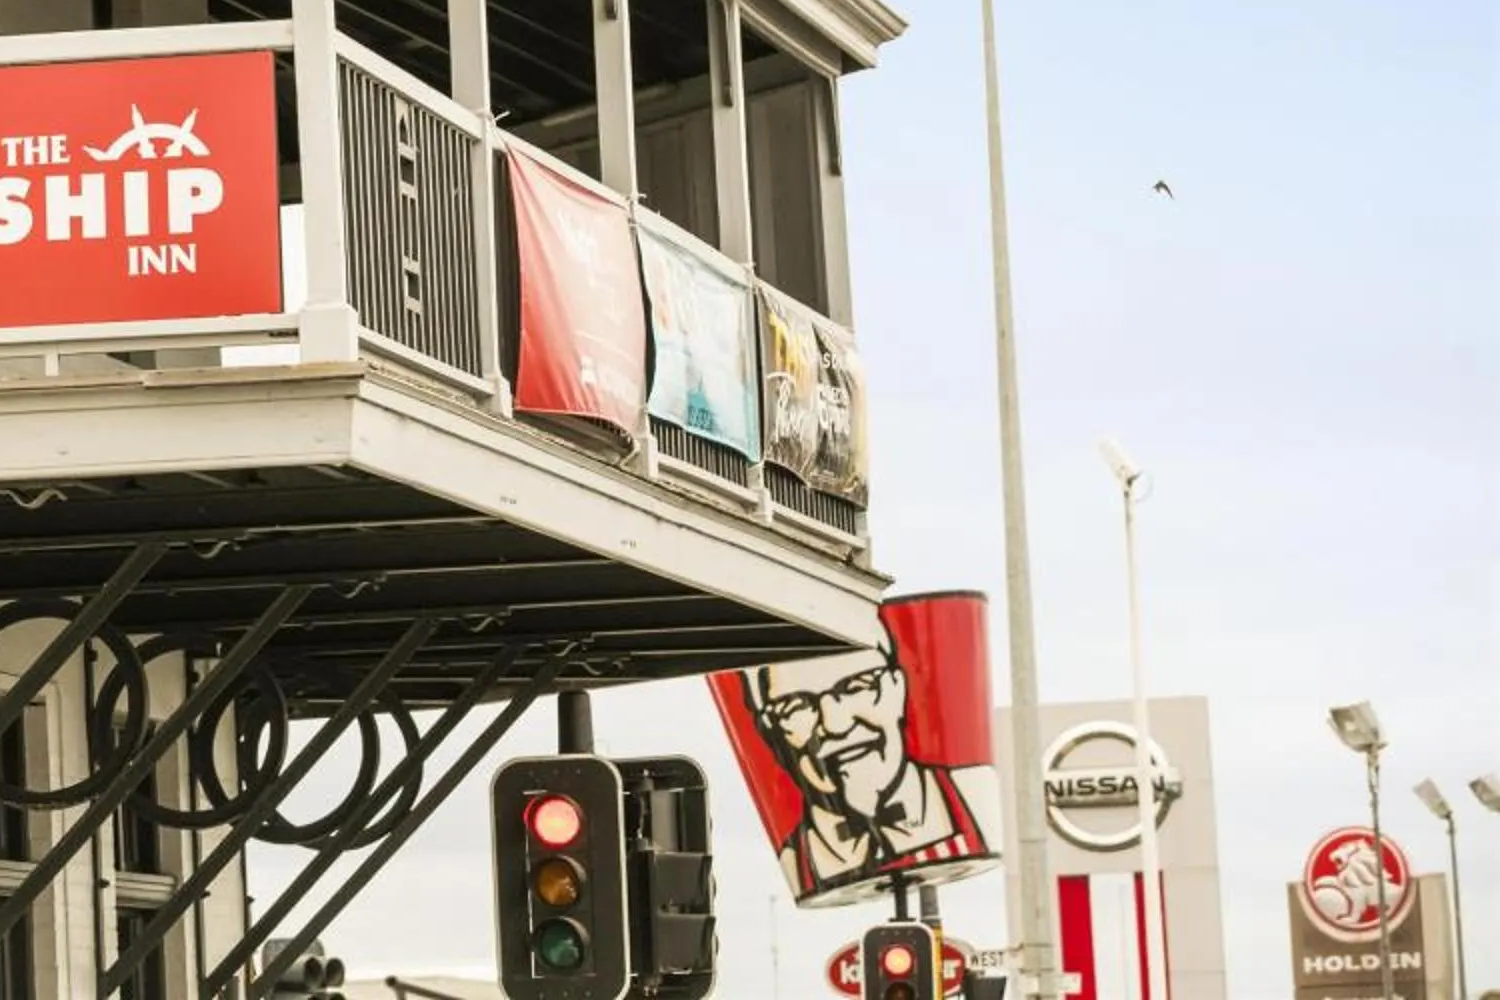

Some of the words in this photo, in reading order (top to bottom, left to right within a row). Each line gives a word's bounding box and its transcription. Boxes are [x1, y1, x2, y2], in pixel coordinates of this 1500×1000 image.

[1, 135, 70, 167] THE
[128, 244, 197, 277] INN
[1043, 775, 1165, 798] NISSAN
